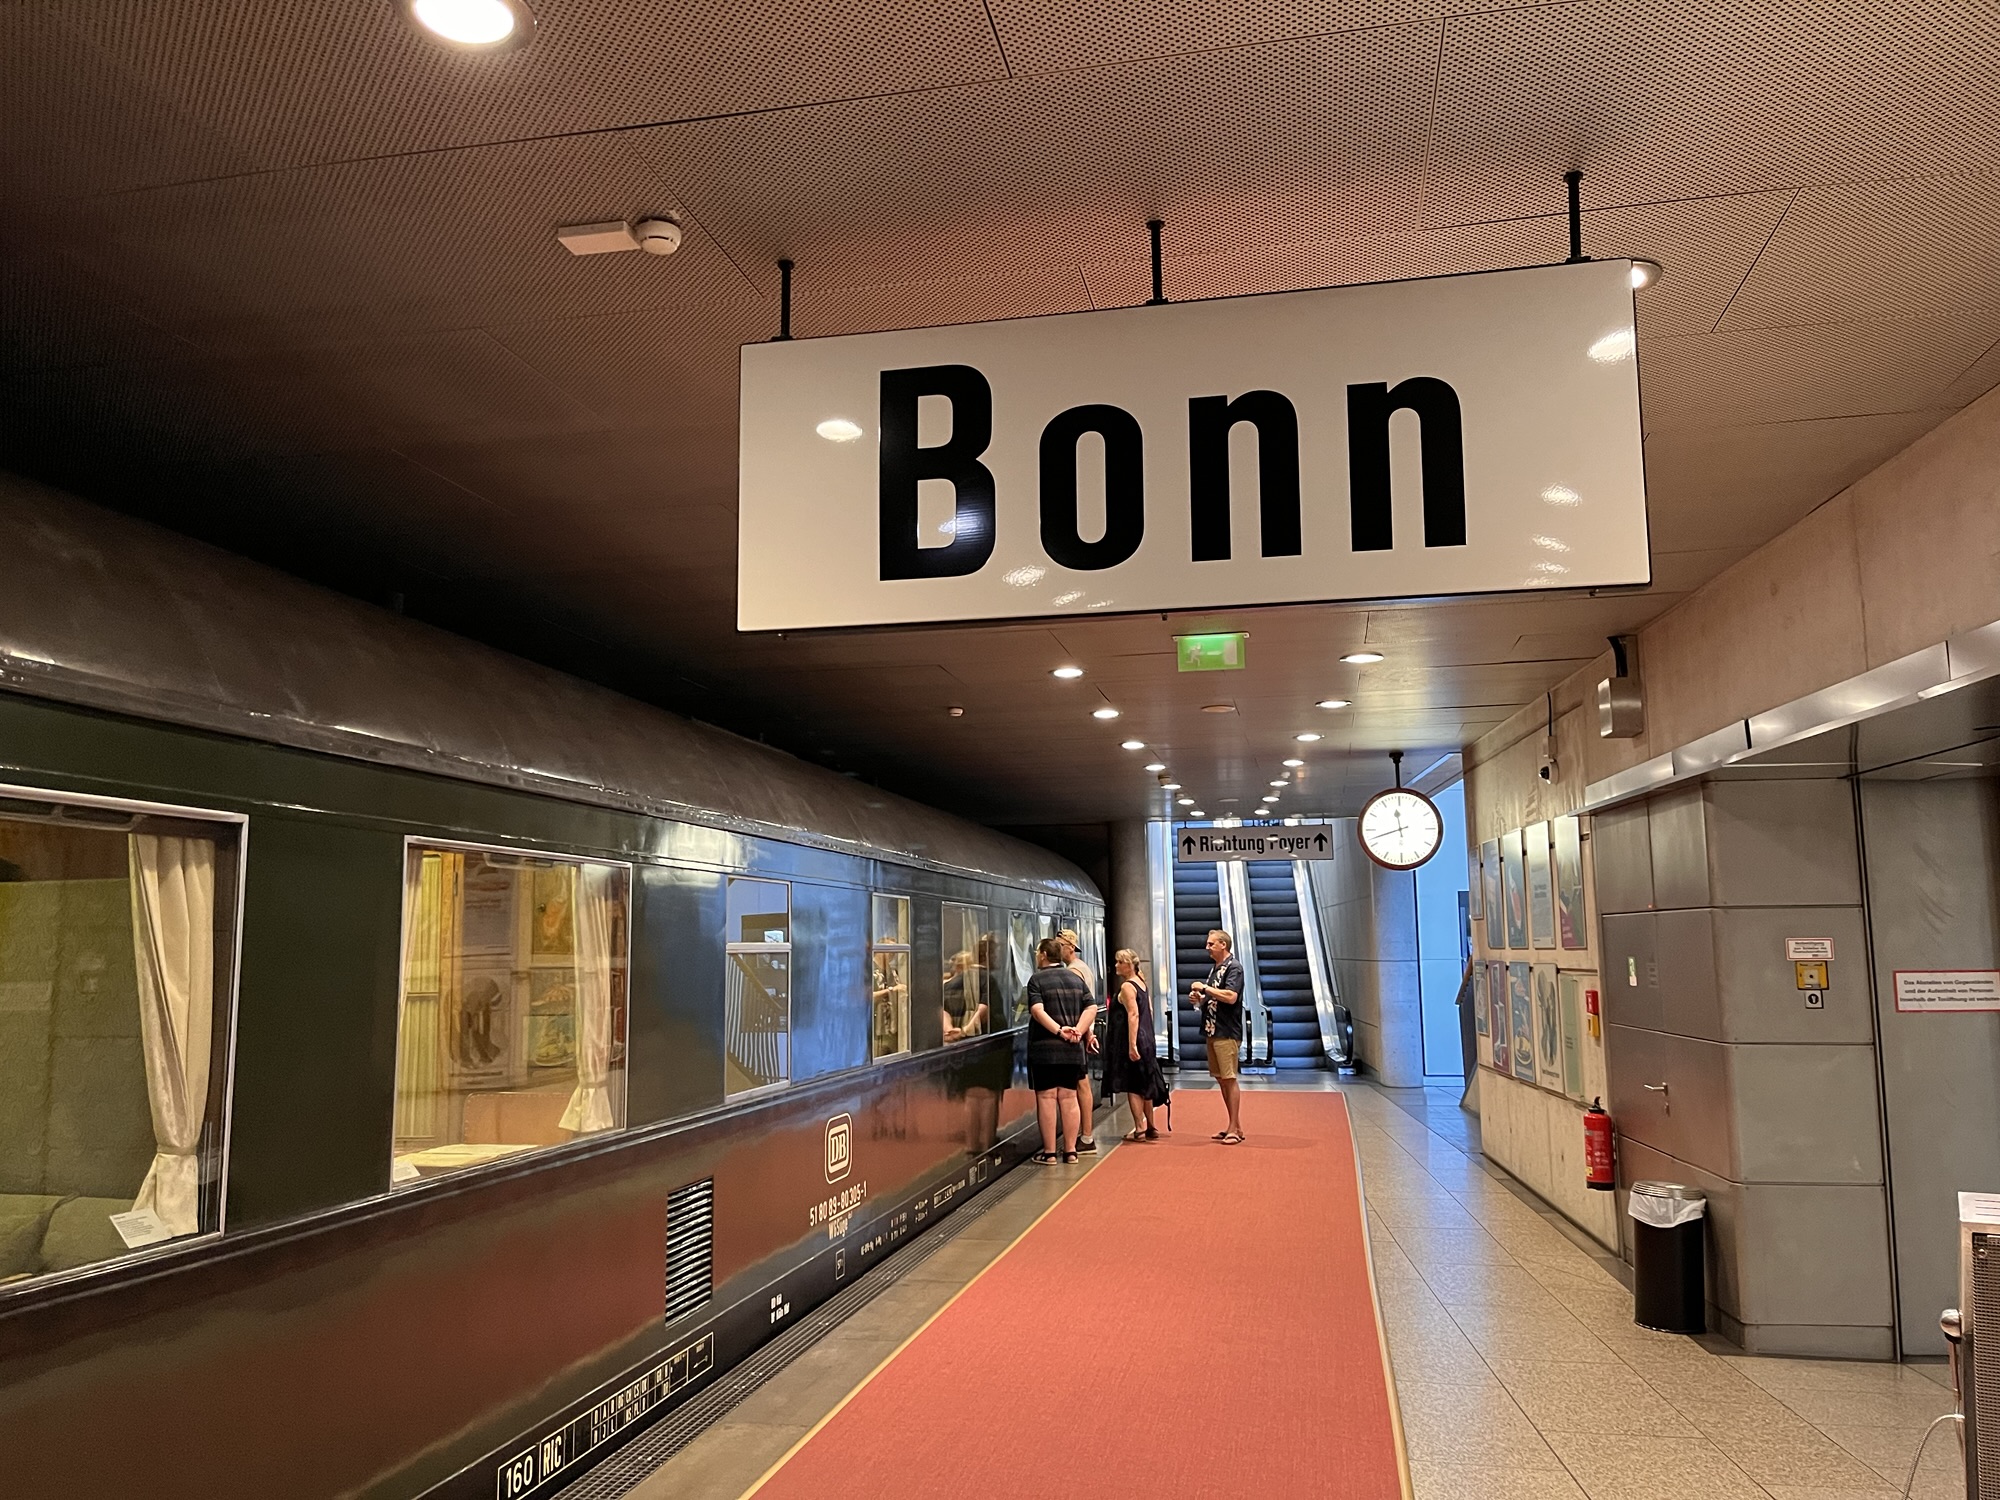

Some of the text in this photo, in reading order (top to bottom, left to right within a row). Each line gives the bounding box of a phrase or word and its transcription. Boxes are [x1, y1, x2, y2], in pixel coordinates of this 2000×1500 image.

[879, 364, 1467, 581] Bonn
[1199, 834, 1310, 854] Richtung Foyer
[830, 1133, 847, 1164] DB
[810, 1207, 818, 1227] 51
[819, 1201, 828, 1223] 80
[506, 1435, 562, 1498] 160 RIC
